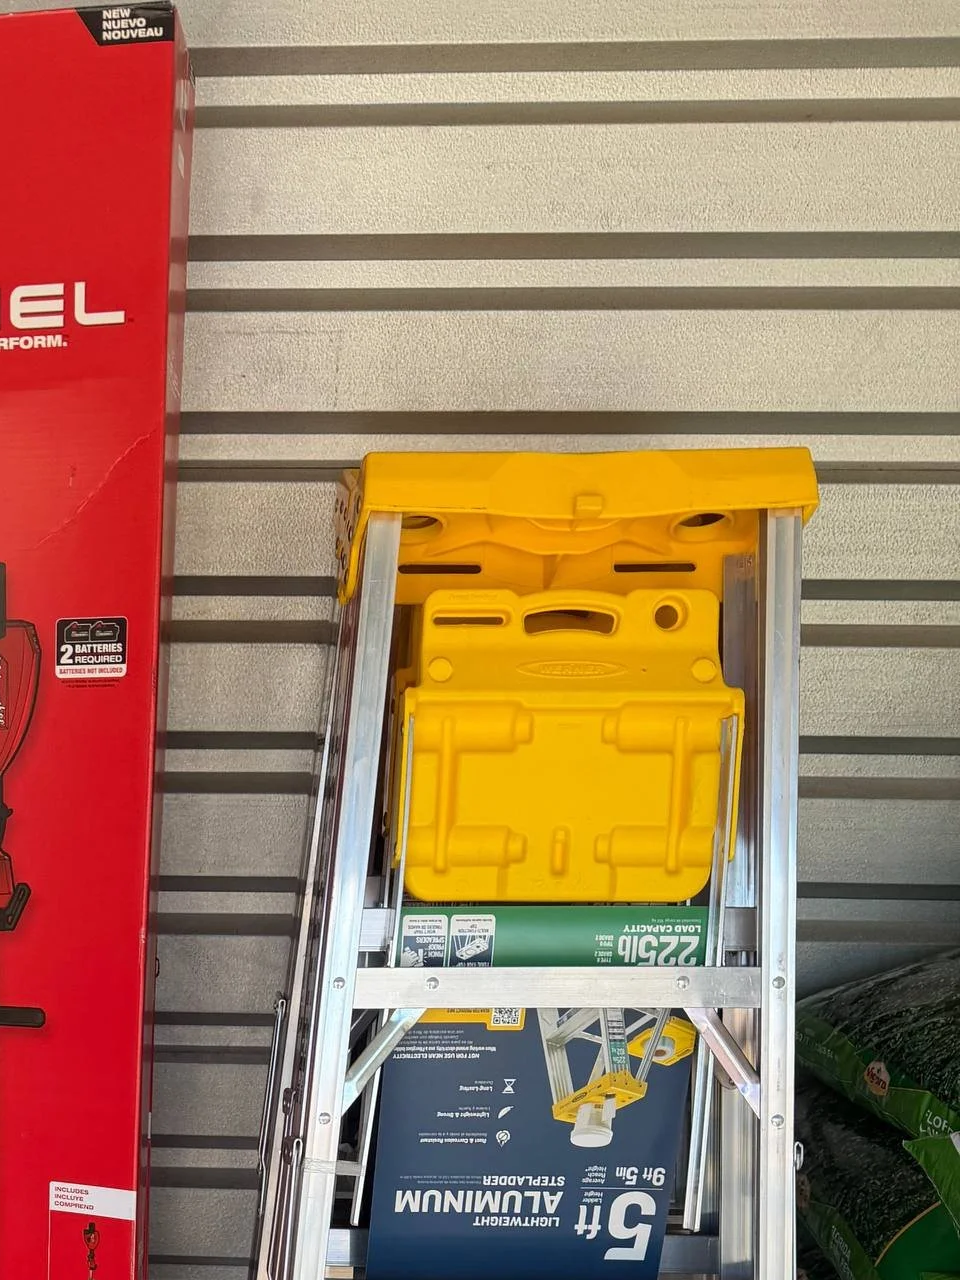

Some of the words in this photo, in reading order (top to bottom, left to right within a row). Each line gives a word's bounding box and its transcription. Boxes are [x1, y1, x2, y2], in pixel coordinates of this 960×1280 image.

[102, 8, 130, 20] NEW
[102, 18, 146, 30] NUEVO
[102, 27, 163, 41] NOUVEAU
[60, 644, 74, 664] 2
[74, 642, 123, 654] BATTERIES
[74, 654, 123, 664] REQUIRED
[623, 924, 673, 932] CAPACITY
[675, 924, 702, 932] LOAD
[416, 936, 445, 944] SPREADERS
[482, 1175, 566, 1186] STEPLADDER
[616, 1166, 638, 1186] 5in
[642, 1168, 666, 1186] 9ft
[54, 1186, 89, 1195] INCLUDES
[54, 1194, 84, 1202] INCLUYE
[394, 1190, 564, 1214] ALUMINUM
[54, 1200, 94, 1210] COMPREND
[472, 1216, 560, 1227] LIGHTWEIGHT
[574, 1204, 602, 1240] ft
[604, 1191, 656, 1261] 5
